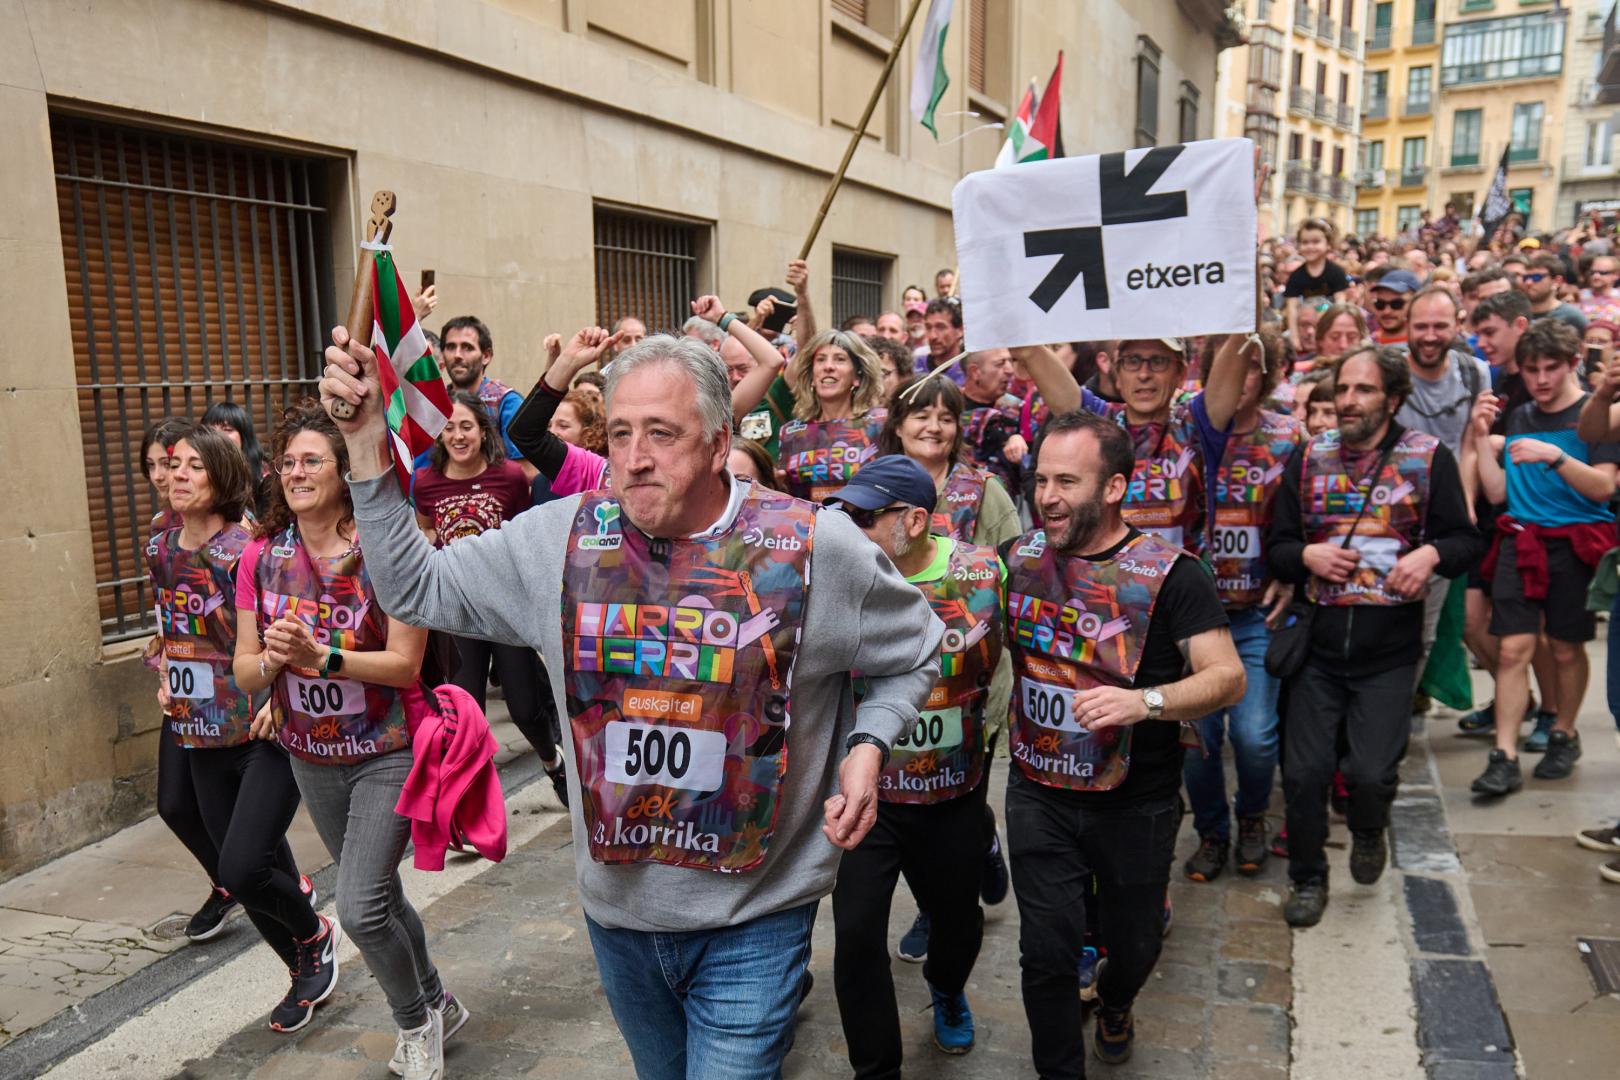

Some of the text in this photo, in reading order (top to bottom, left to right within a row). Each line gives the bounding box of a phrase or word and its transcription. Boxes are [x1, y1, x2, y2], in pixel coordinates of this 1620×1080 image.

[1127, 261, 1225, 290] etxera
[764, 534, 801, 551] eitb
[968, 569, 994, 580] eitb
[575, 602, 740, 648] HARRO
[1008, 591, 1102, 639] HARRO
[573, 636, 736, 684] HERRI
[297, 681, 344, 714] 500
[629, 696, 695, 715] euskaltel
[1028, 687, 1066, 727] 500
[625, 728, 691, 779] 500
[626, 789, 678, 821] aek
